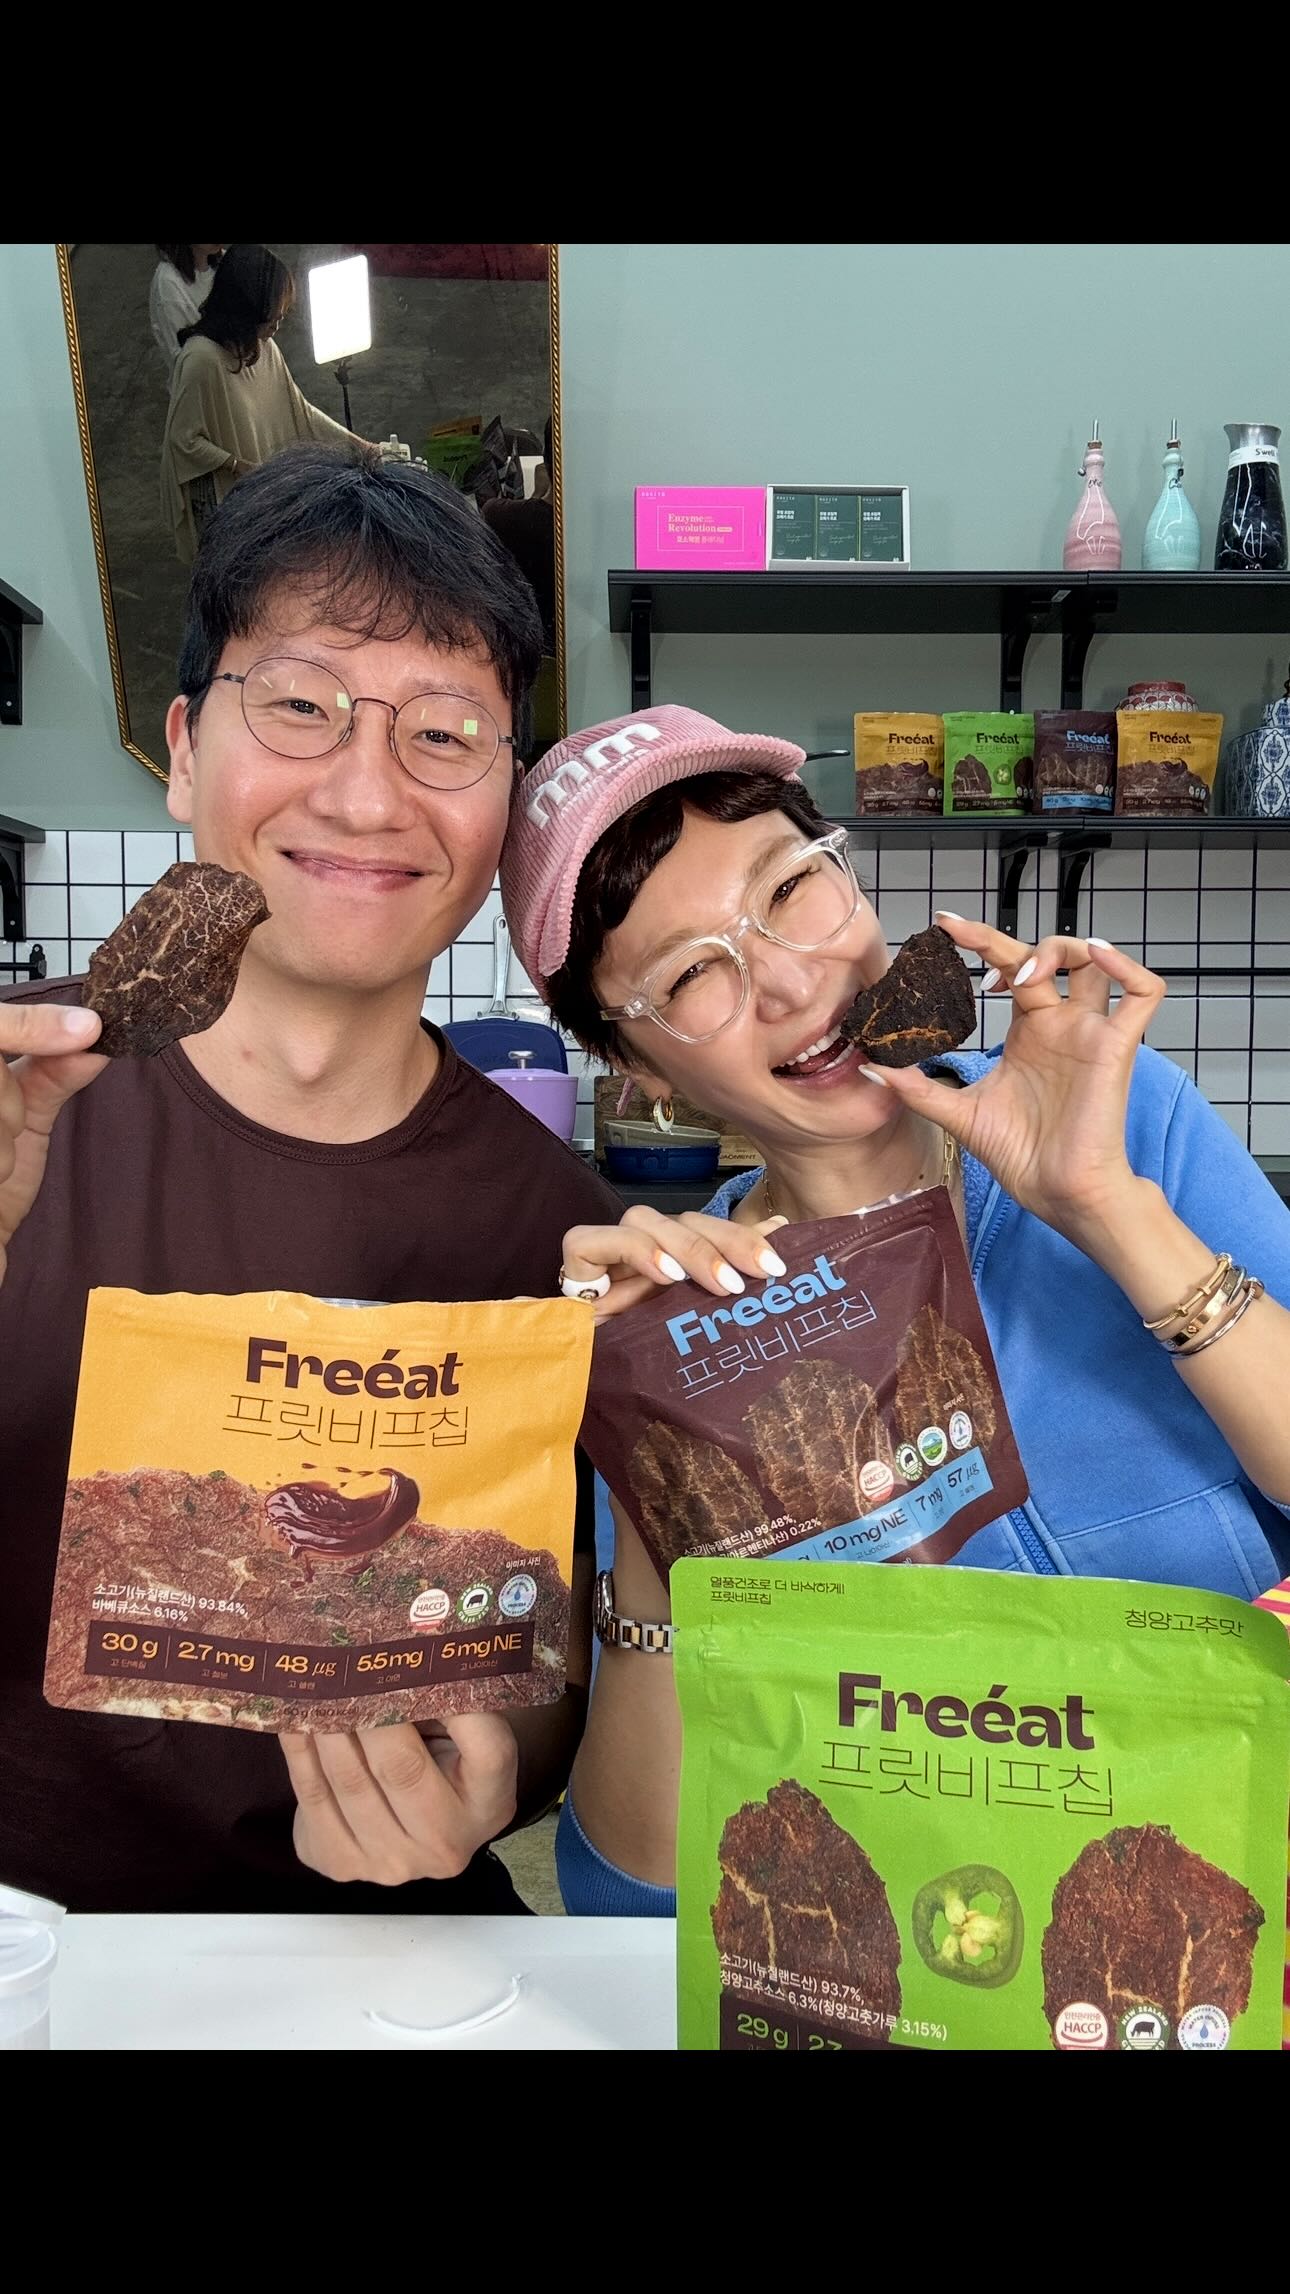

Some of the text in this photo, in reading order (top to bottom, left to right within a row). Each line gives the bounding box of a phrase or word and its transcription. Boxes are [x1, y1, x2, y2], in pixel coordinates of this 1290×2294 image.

[668, 513, 704, 524] Enzyme
[668, 523, 717, 532] Revolution
[665, 1254, 847, 1356] Freéat
[675, 1290, 878, 1400] 프릿비프칩
[246, 1336, 464, 1400] Freéat
[222, 1394, 468, 1449] 프릿비프칩
[947, 1467, 963, 1488] 57
[915, 1495, 927, 1512] 7
[754, 1514, 797, 1537] 99.48%,
[790, 1517, 822, 1536] 0.22%
[824, 1536, 847, 1554] 10
[851, 1526, 882, 1547] mg
[527, 1556, 541, 1567] 사진
[710, 1576, 845, 1595] 열풍건조로 더 바삭하게!
[92, 1583, 250, 1621] 소고기(뉴질랜드산) 93.84%,
[416, 1602, 446, 1613] HACCP
[711, 1590, 772, 1605] 프릿비프칩
[91, 1600, 190, 1623] 바베큐소스 6.16%
[1124, 1608, 1245, 1638] 청양고추맛
[101, 1632, 159, 1659] 30 g
[215, 1649, 256, 1673] mg
[274, 1654, 309, 1674] 48
[838, 1671, 1095, 1751] Freéat
[818, 1741, 1113, 1817] 프릿비프칩
[719, 1951, 865, 2006] 소고기(뉴질랜드산) 93.7%,
[719, 1969, 786, 2001] 청양고추소스
[901, 2019, 948, 2042] 3.15%)
[1121, 2005, 1169, 2026] NEW ZEALAND
[737, 2013, 788, 2049] 29 g
[1064, 2022, 1102, 2034] HACCP
